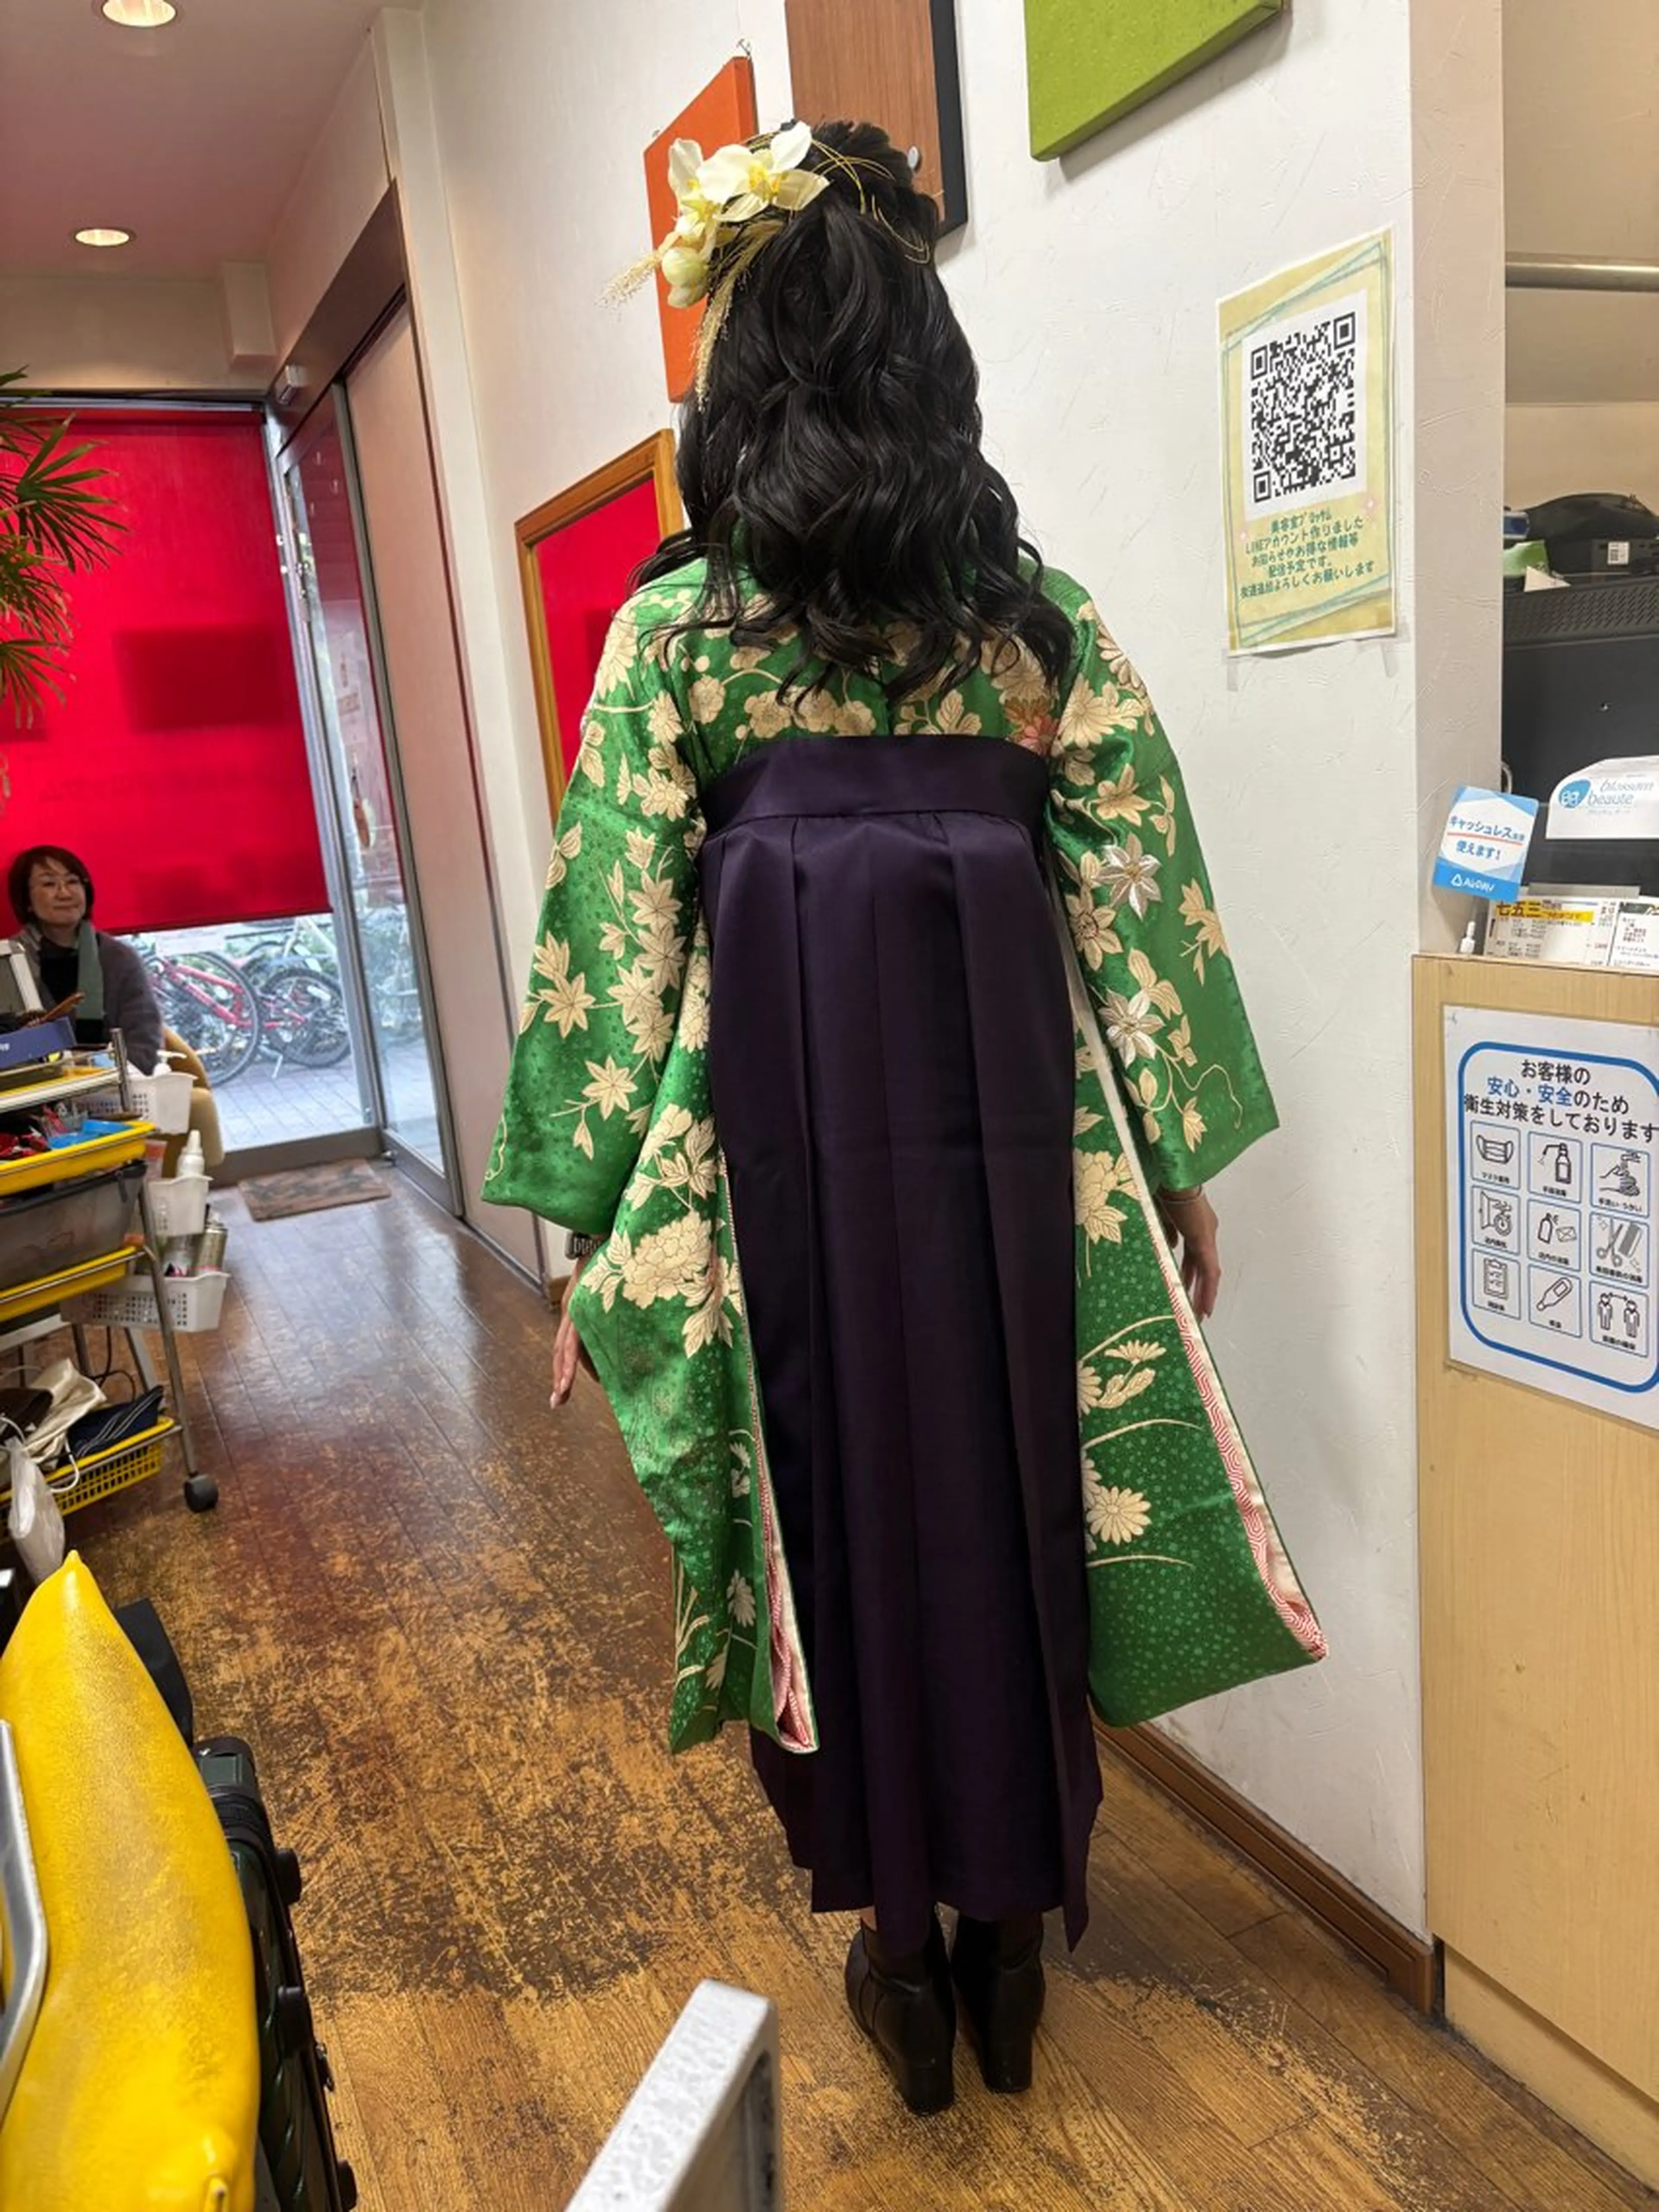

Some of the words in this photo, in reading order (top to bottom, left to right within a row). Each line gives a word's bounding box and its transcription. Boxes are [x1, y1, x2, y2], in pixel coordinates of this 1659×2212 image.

[1450, 815, 1525, 841] キャッシュレス
[1496, 900, 1541, 918] 七五三
[1521, 1059, 1591, 1085] お客様の
[1487, 1077, 1629, 1115] 安心・安全のため
[1463, 1093, 1659, 1143] 衛生対策をしております
[1538, 1251, 1569, 1265] 店内の
